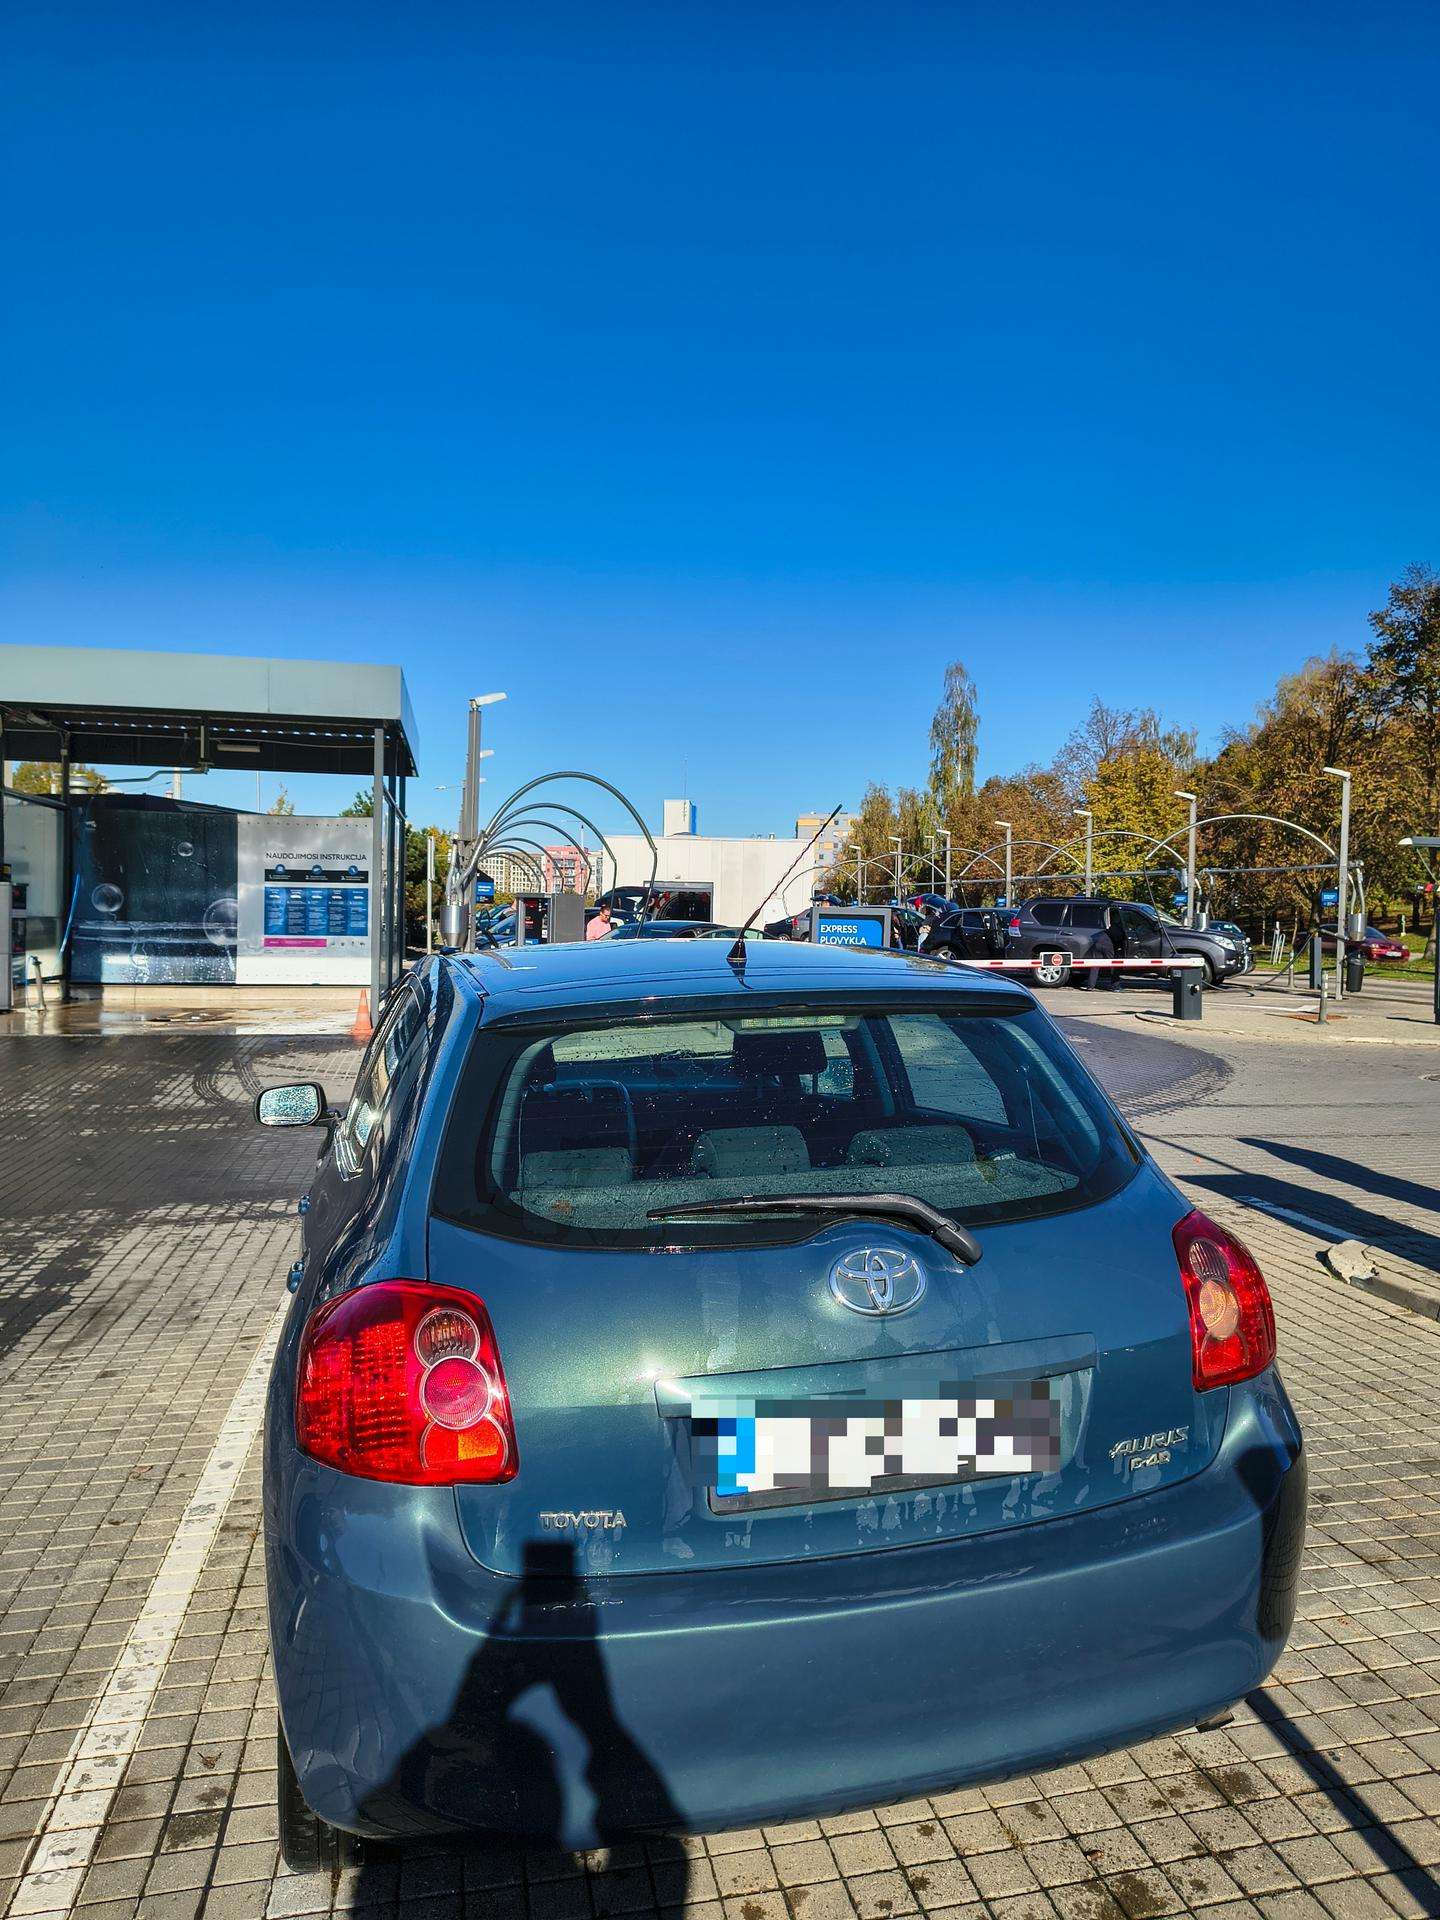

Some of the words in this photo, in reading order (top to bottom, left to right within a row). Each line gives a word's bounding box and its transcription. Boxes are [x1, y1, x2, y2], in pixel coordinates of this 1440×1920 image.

[266, 852, 319, 860] NAUDOJIMOSI
[320, 853, 367, 861] INSTRUKCIJA
[820, 925, 858, 933] EXPRESS
[820, 936, 867, 945] PLOVYKLA
[1109, 1425, 1190, 1459] AURIS
[539, 1510, 628, 1530] TOYOTA
